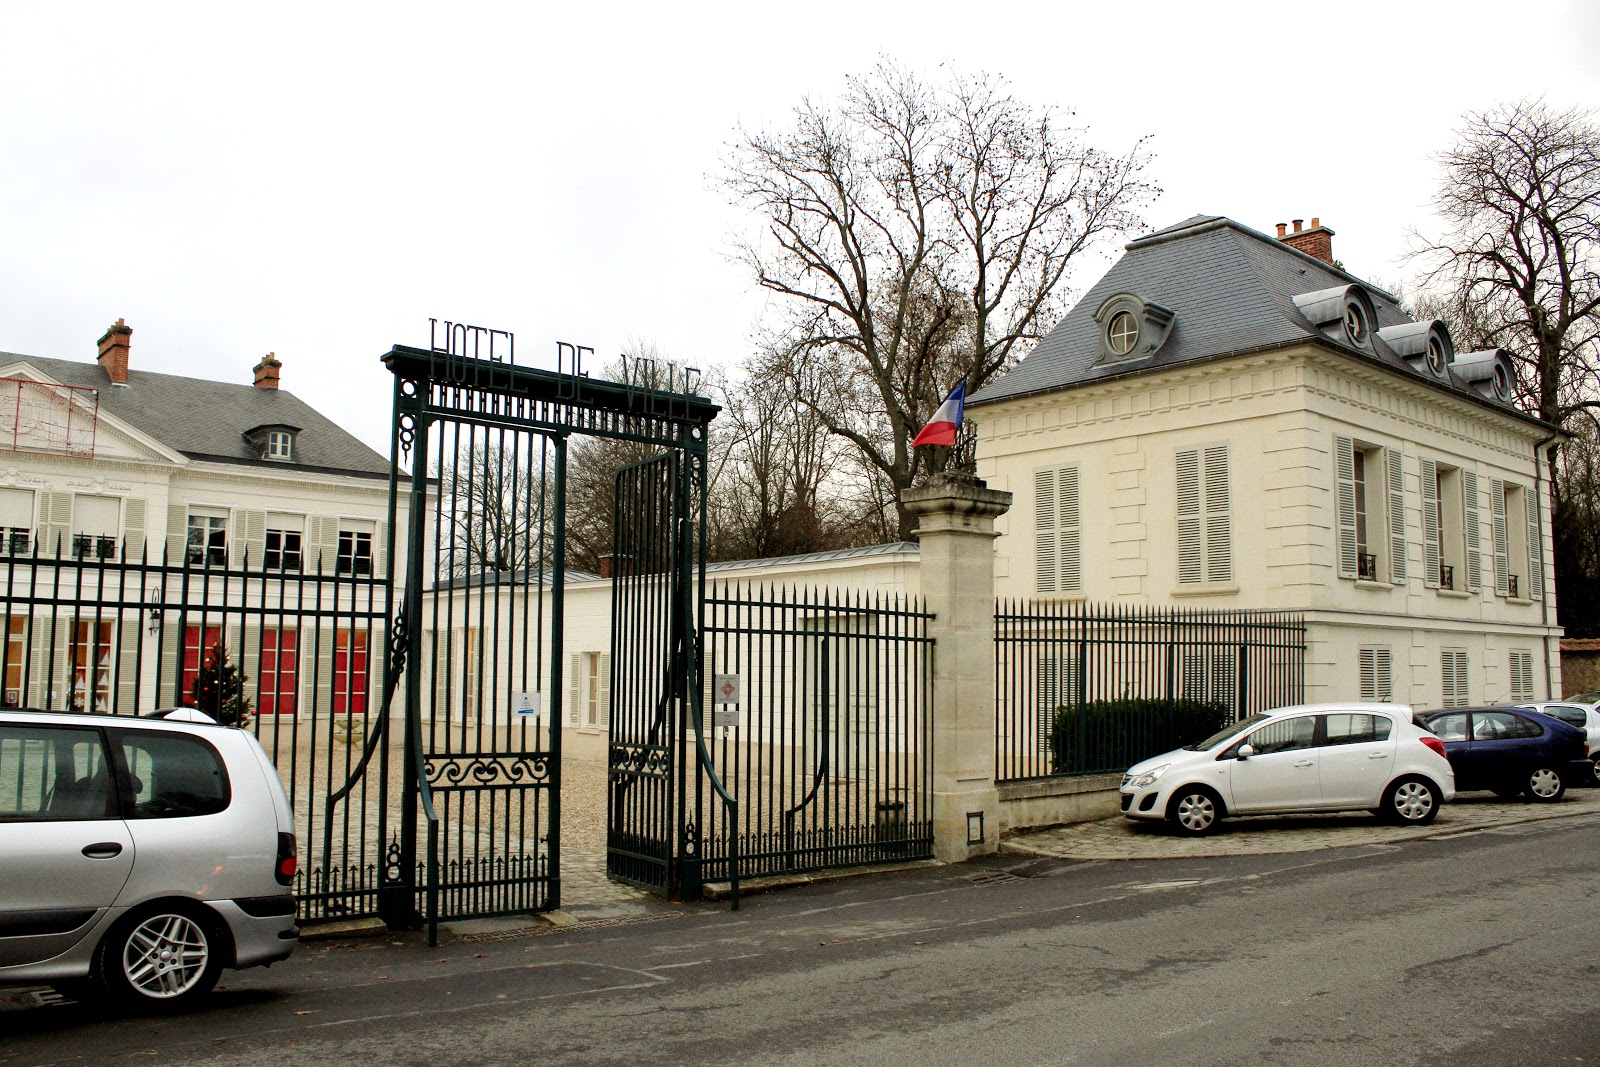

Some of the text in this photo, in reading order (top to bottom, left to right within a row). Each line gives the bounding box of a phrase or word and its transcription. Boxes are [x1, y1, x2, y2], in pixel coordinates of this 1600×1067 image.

[428, 318, 701, 423] HOTEL DE VILLE
